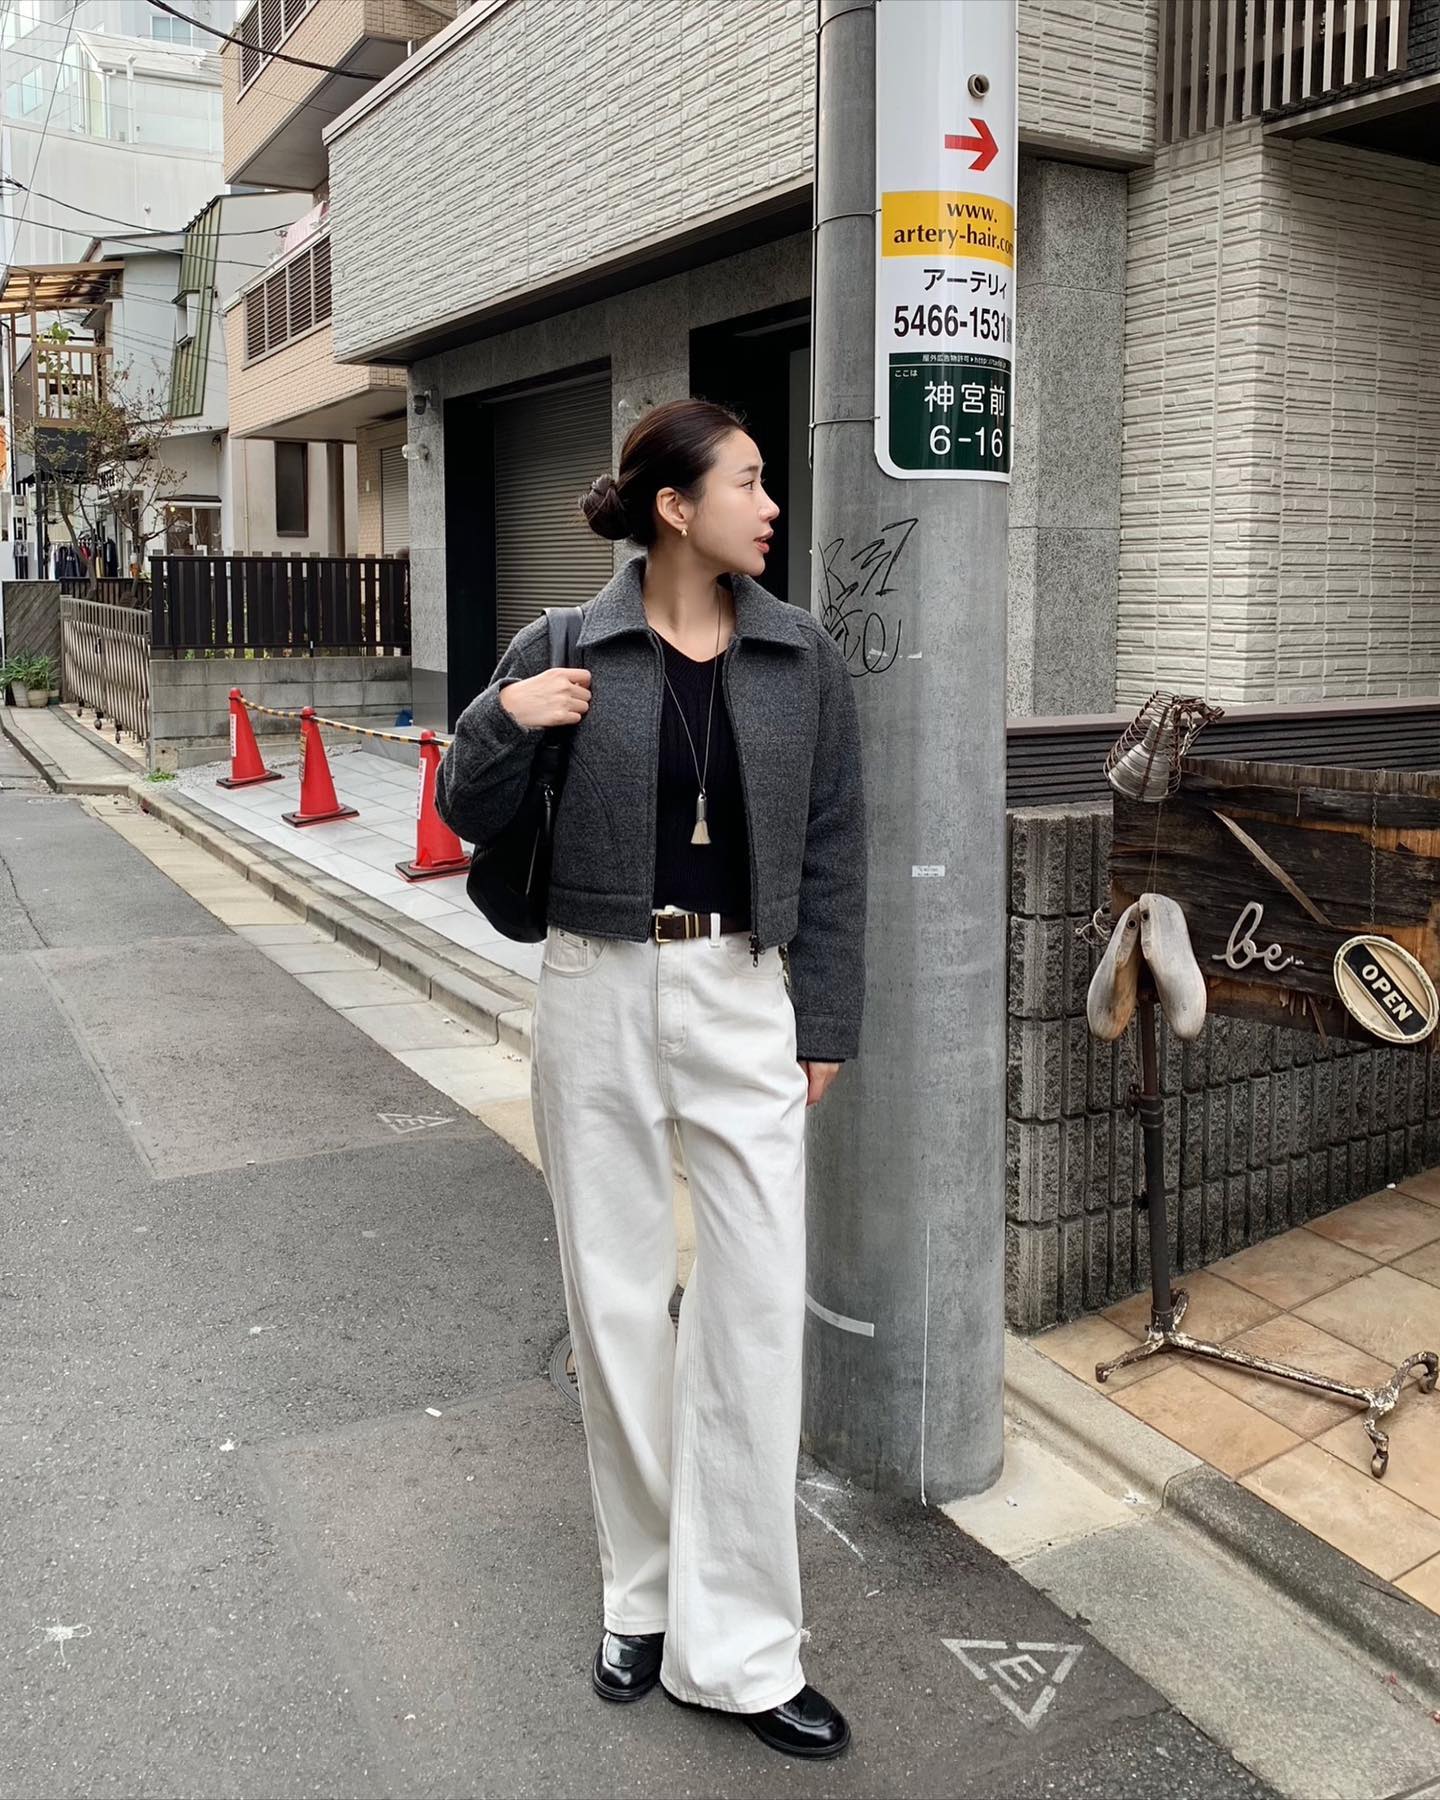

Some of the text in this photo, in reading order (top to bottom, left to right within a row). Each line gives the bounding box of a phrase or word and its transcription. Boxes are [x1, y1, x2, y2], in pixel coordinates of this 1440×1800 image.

[947, 203, 998, 223] www.
[923, 269, 1007, 299] アーテリィ
[894, 305, 1006, 343] 5466-1531
[895, 369, 918, 378] ここは
[924, 380, 1006, 417] 神宮前
[929, 425, 1004, 458] 6-16
[1361, 964, 1413, 1022] OPEN
